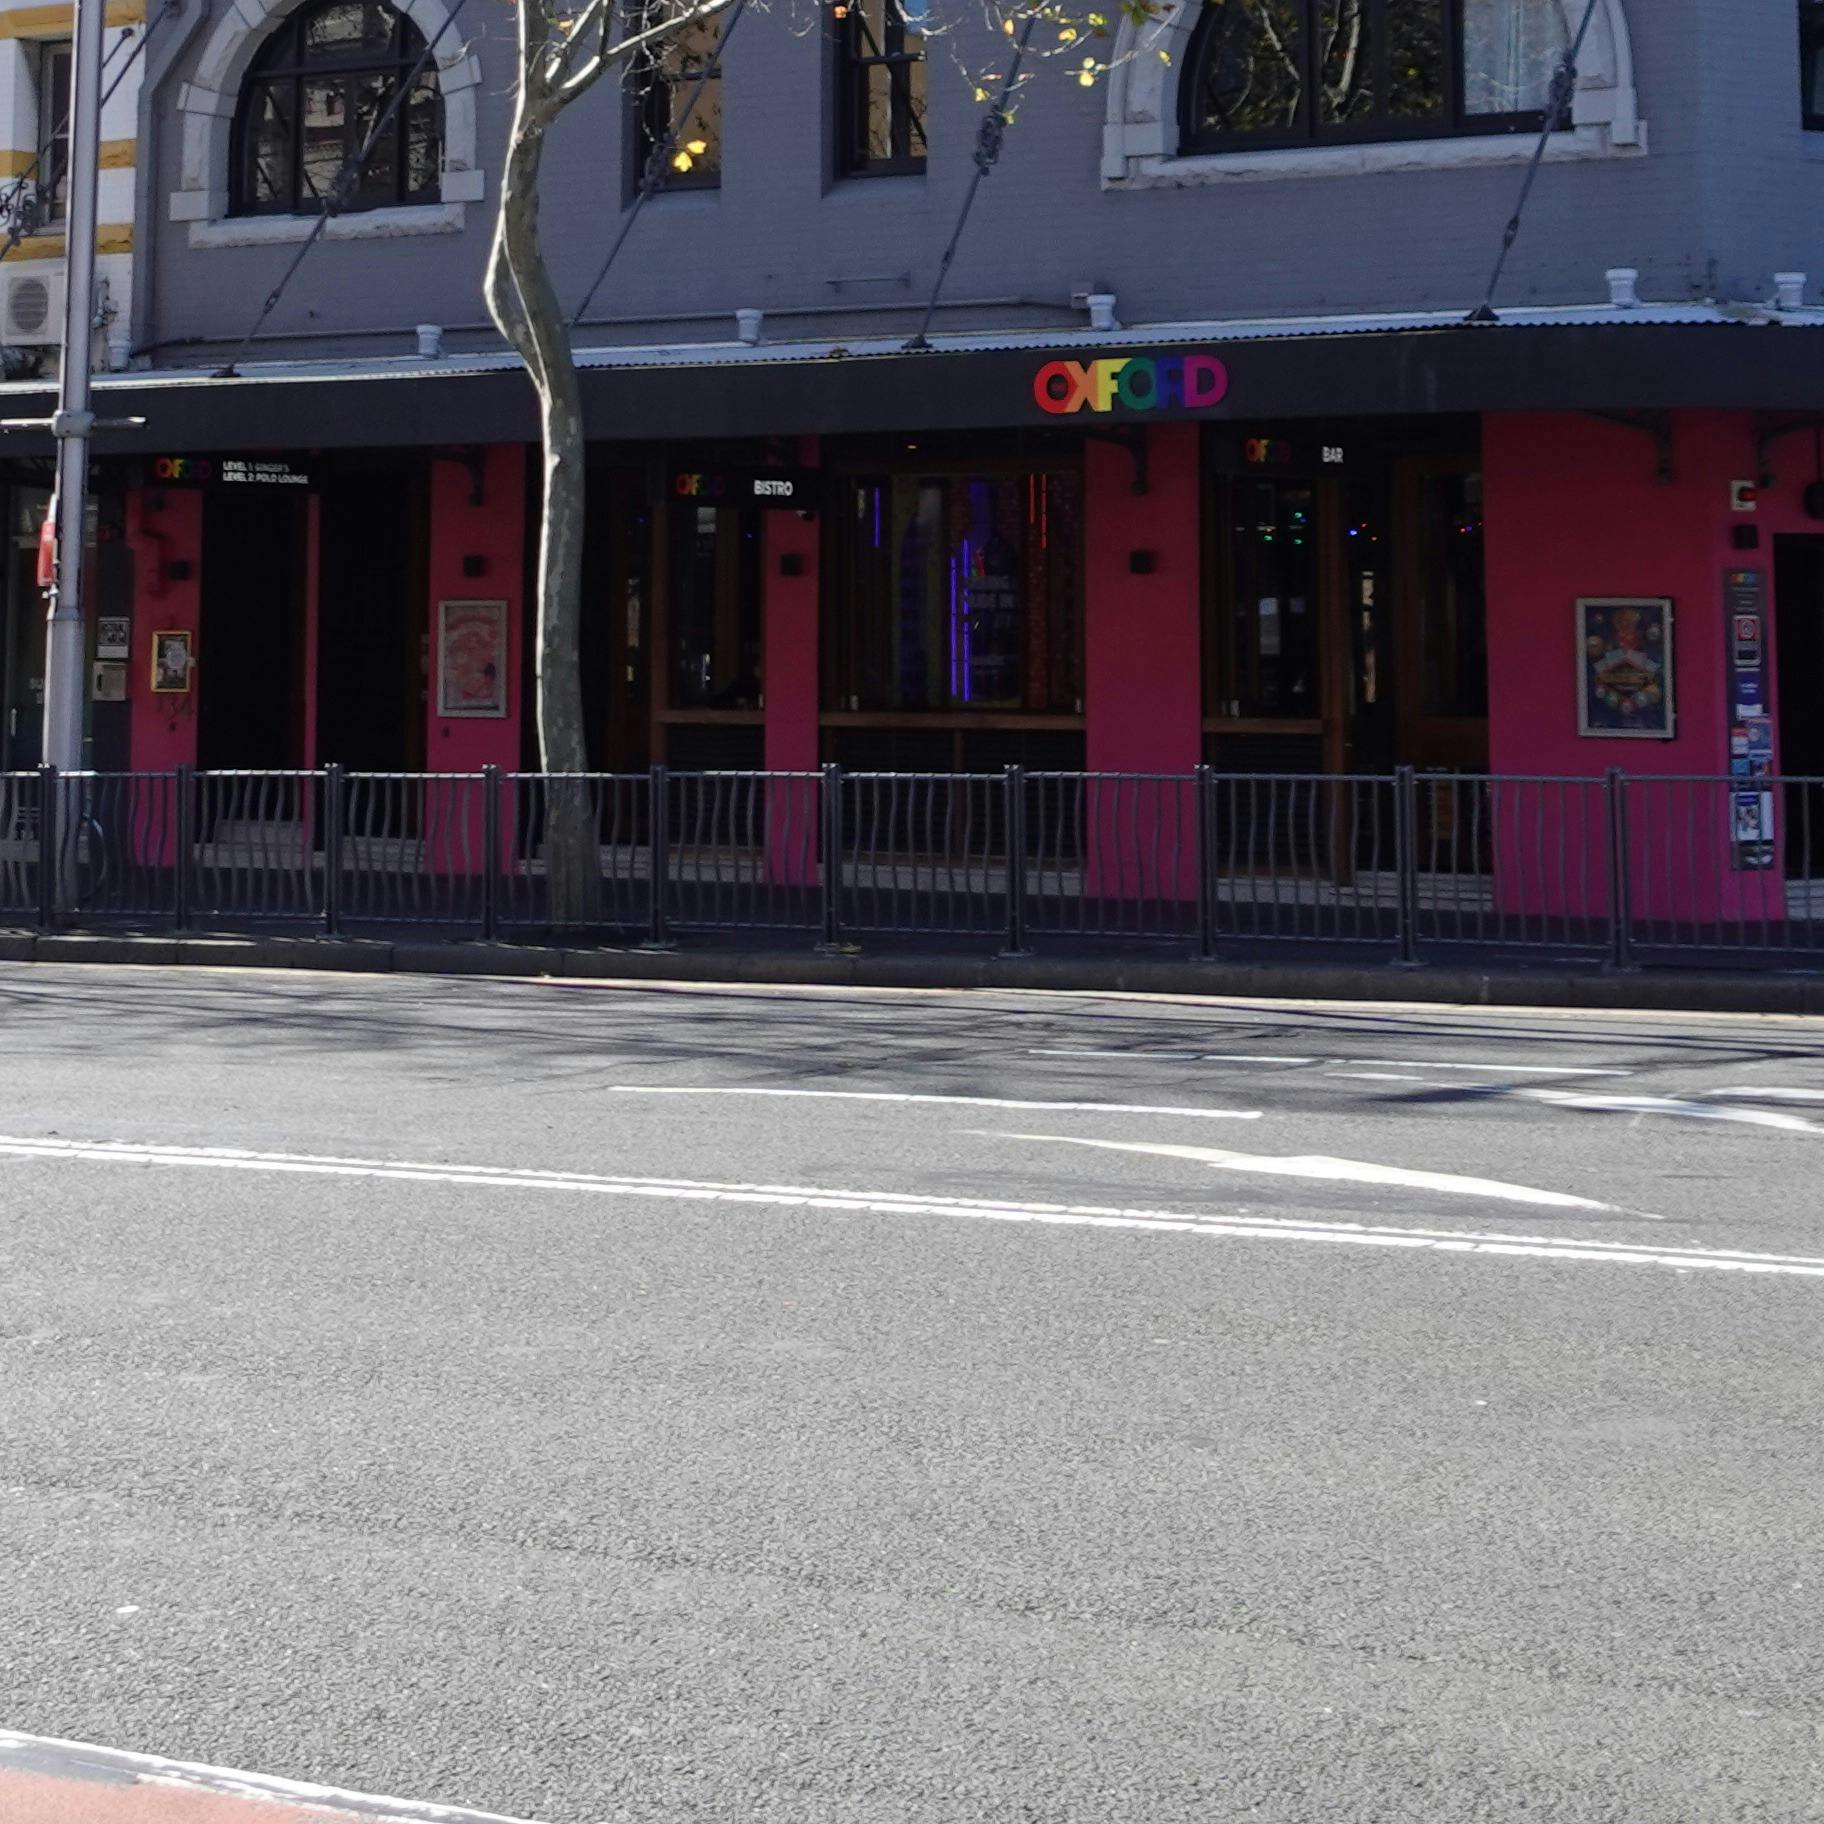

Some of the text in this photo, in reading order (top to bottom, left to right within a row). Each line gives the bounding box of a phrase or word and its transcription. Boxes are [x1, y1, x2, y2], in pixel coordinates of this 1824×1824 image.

[1034, 355, 1228, 414] OXFORD
[1247, 438, 1344, 463] OXFD BAR
[223, 460, 247, 471] LEVEL
[223, 471, 247, 482] LEVEL
[675, 474, 794, 496] OXFD BISTRO
